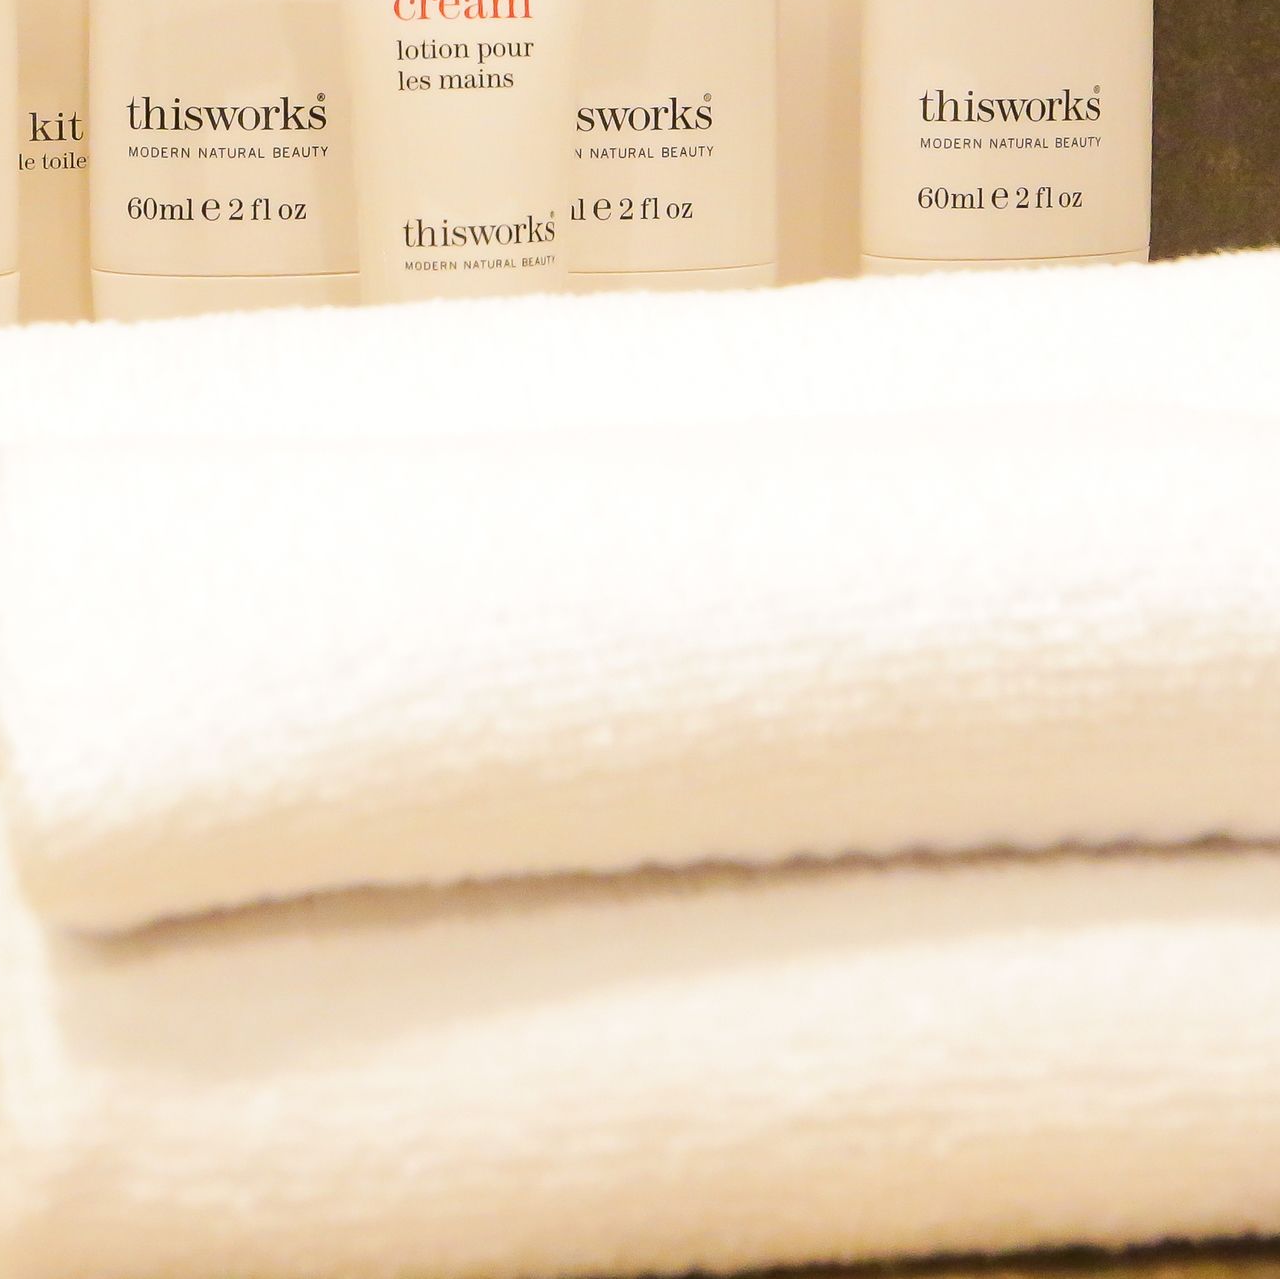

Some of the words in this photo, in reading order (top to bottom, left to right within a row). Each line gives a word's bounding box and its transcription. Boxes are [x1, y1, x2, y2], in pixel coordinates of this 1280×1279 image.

[396, 39, 470, 61] lotion
[477, 42, 535, 65] pour
[398, 70, 431, 92] les
[439, 68, 514, 90] mains
[28, 111, 84, 142] kit
[128, 145, 191, 159] MODERN
[198, 147, 266, 159] NATURAL
[272, 145, 329, 159] BEAUTY
[589, 147, 655, 159] NATURAL
[661, 145, 714, 159] BEAUTY
[920, 137, 983, 150] MODERN
[989, 137, 1049, 150] NATURAL
[1054, 136, 1102, 149] BEAUTY
[41, 151, 89, 171] toile
[127, 196, 195, 221] 60ml
[228, 198, 244, 221] 2
[250, 197, 272, 221] fl
[278, 203, 307, 221] oz
[619, 197, 634, 221] 2
[640, 197, 661, 220] fl
[666, 202, 693, 220] oz
[917, 186, 985, 210] 60ml
[1015, 186, 1030, 209] 2
[1035, 186, 1054, 209] fl
[1058, 191, 1083, 209] oz
[404, 260, 457, 272] MODERN
[463, 258, 517, 271] NATURAL
[521, 255, 556, 268] BEAUTY
